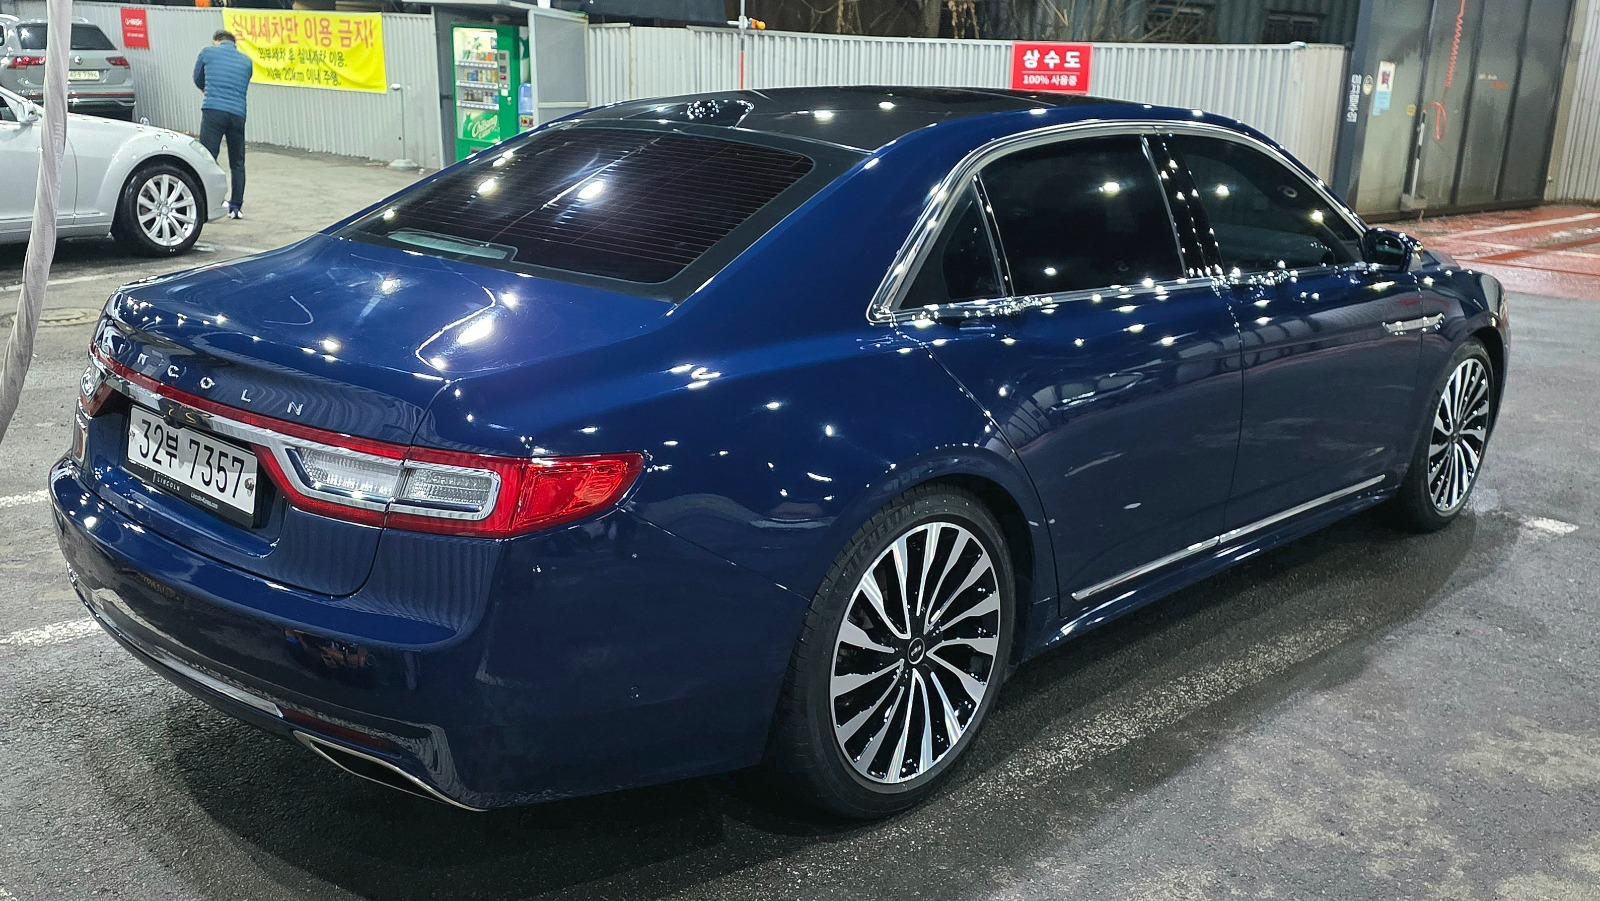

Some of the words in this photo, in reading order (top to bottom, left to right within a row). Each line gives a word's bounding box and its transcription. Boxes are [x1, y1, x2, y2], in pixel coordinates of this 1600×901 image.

[232, 15, 298, 44] 실내세차만
[304, 17, 333, 48] 이용
[338, 19, 374, 49] 금지!
[1023, 74, 1050, 85] 100%
[1051, 75, 1078, 87] 사용중
[103, 335, 304, 416] INCOLN
[139, 418, 179, 469] 32부
[189, 438, 245, 499] 7357
[157, 475, 180, 492] LINCOLN
